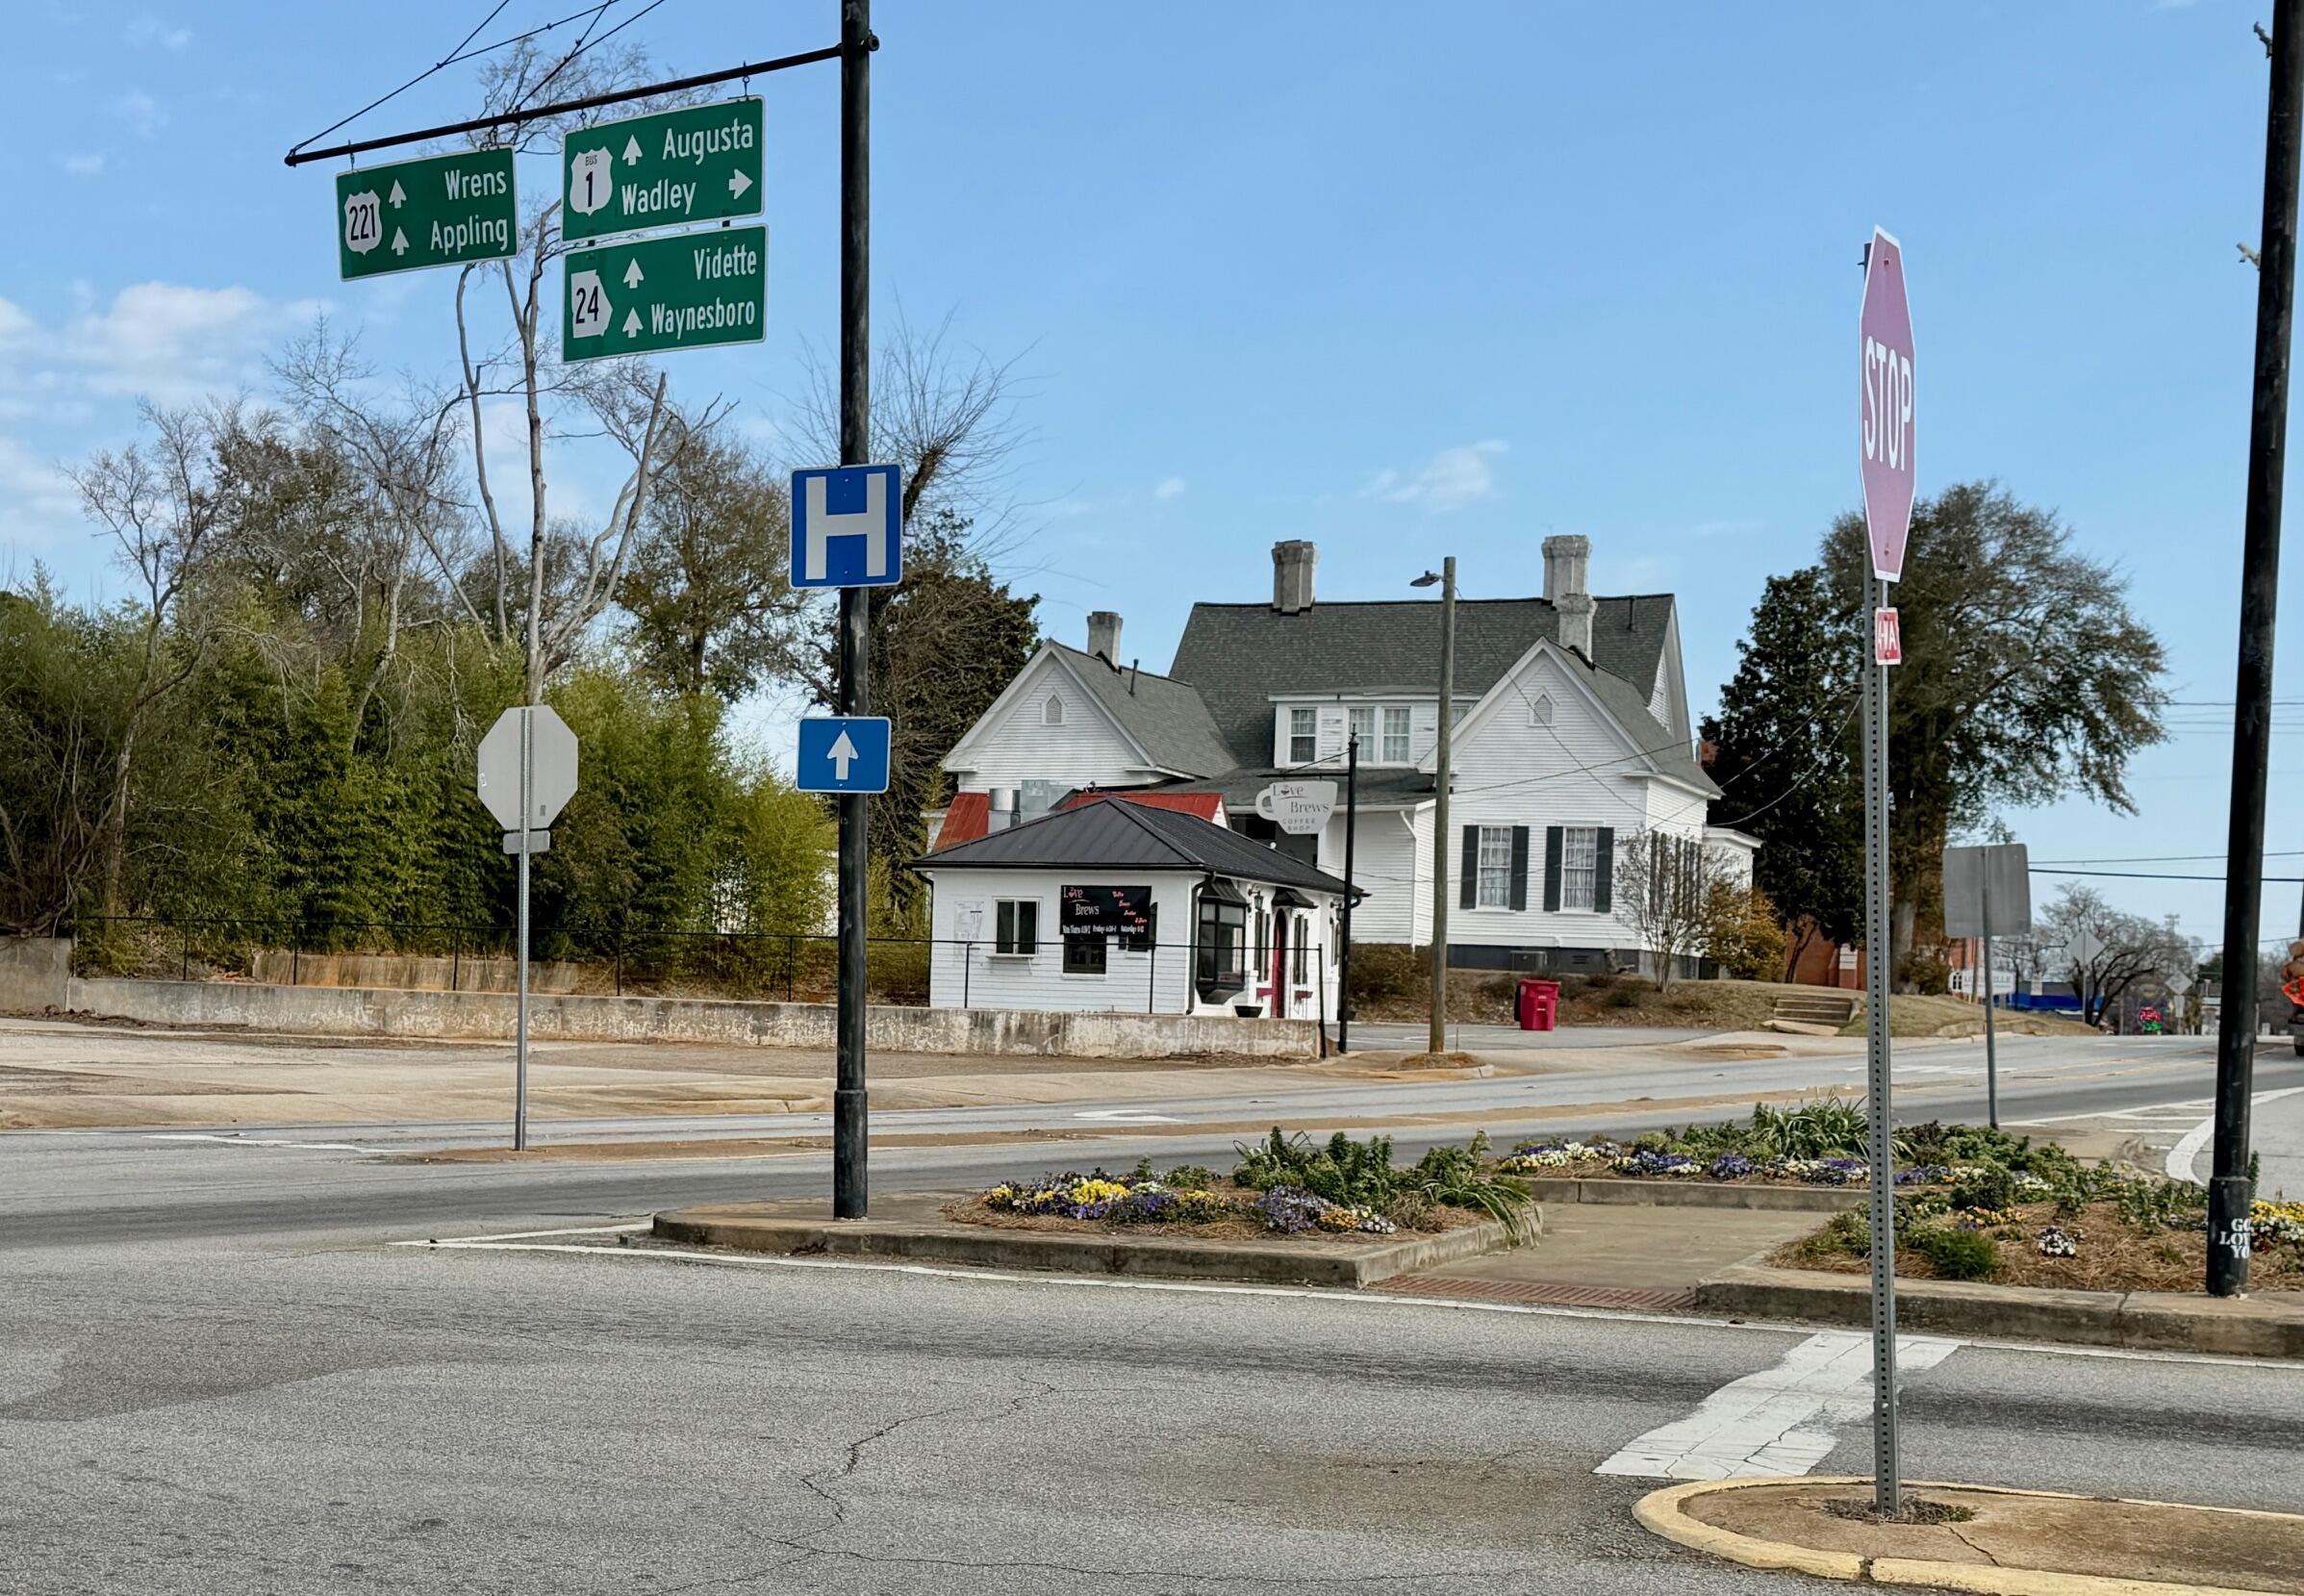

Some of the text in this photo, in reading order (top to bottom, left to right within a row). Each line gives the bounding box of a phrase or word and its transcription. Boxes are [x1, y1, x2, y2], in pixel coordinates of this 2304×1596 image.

[662, 117, 753, 165] Augusta
[585, 155, 597, 166] BUS
[444, 168, 507, 200] Wrens
[585, 171, 594, 207] 1
[621, 178, 696, 215] Wadley
[349, 203, 376, 241] 221
[430, 215, 508, 256] Appling
[694, 243, 757, 281] Vidette
[575, 286, 599, 324] 24
[651, 297, 755, 341] Waynesboro
[1864, 335, 1912, 471] STOP
[805, 472, 887, 580] H
[1290, 801, 1329, 814] Brews
[1075, 903, 1100, 916] Brews
